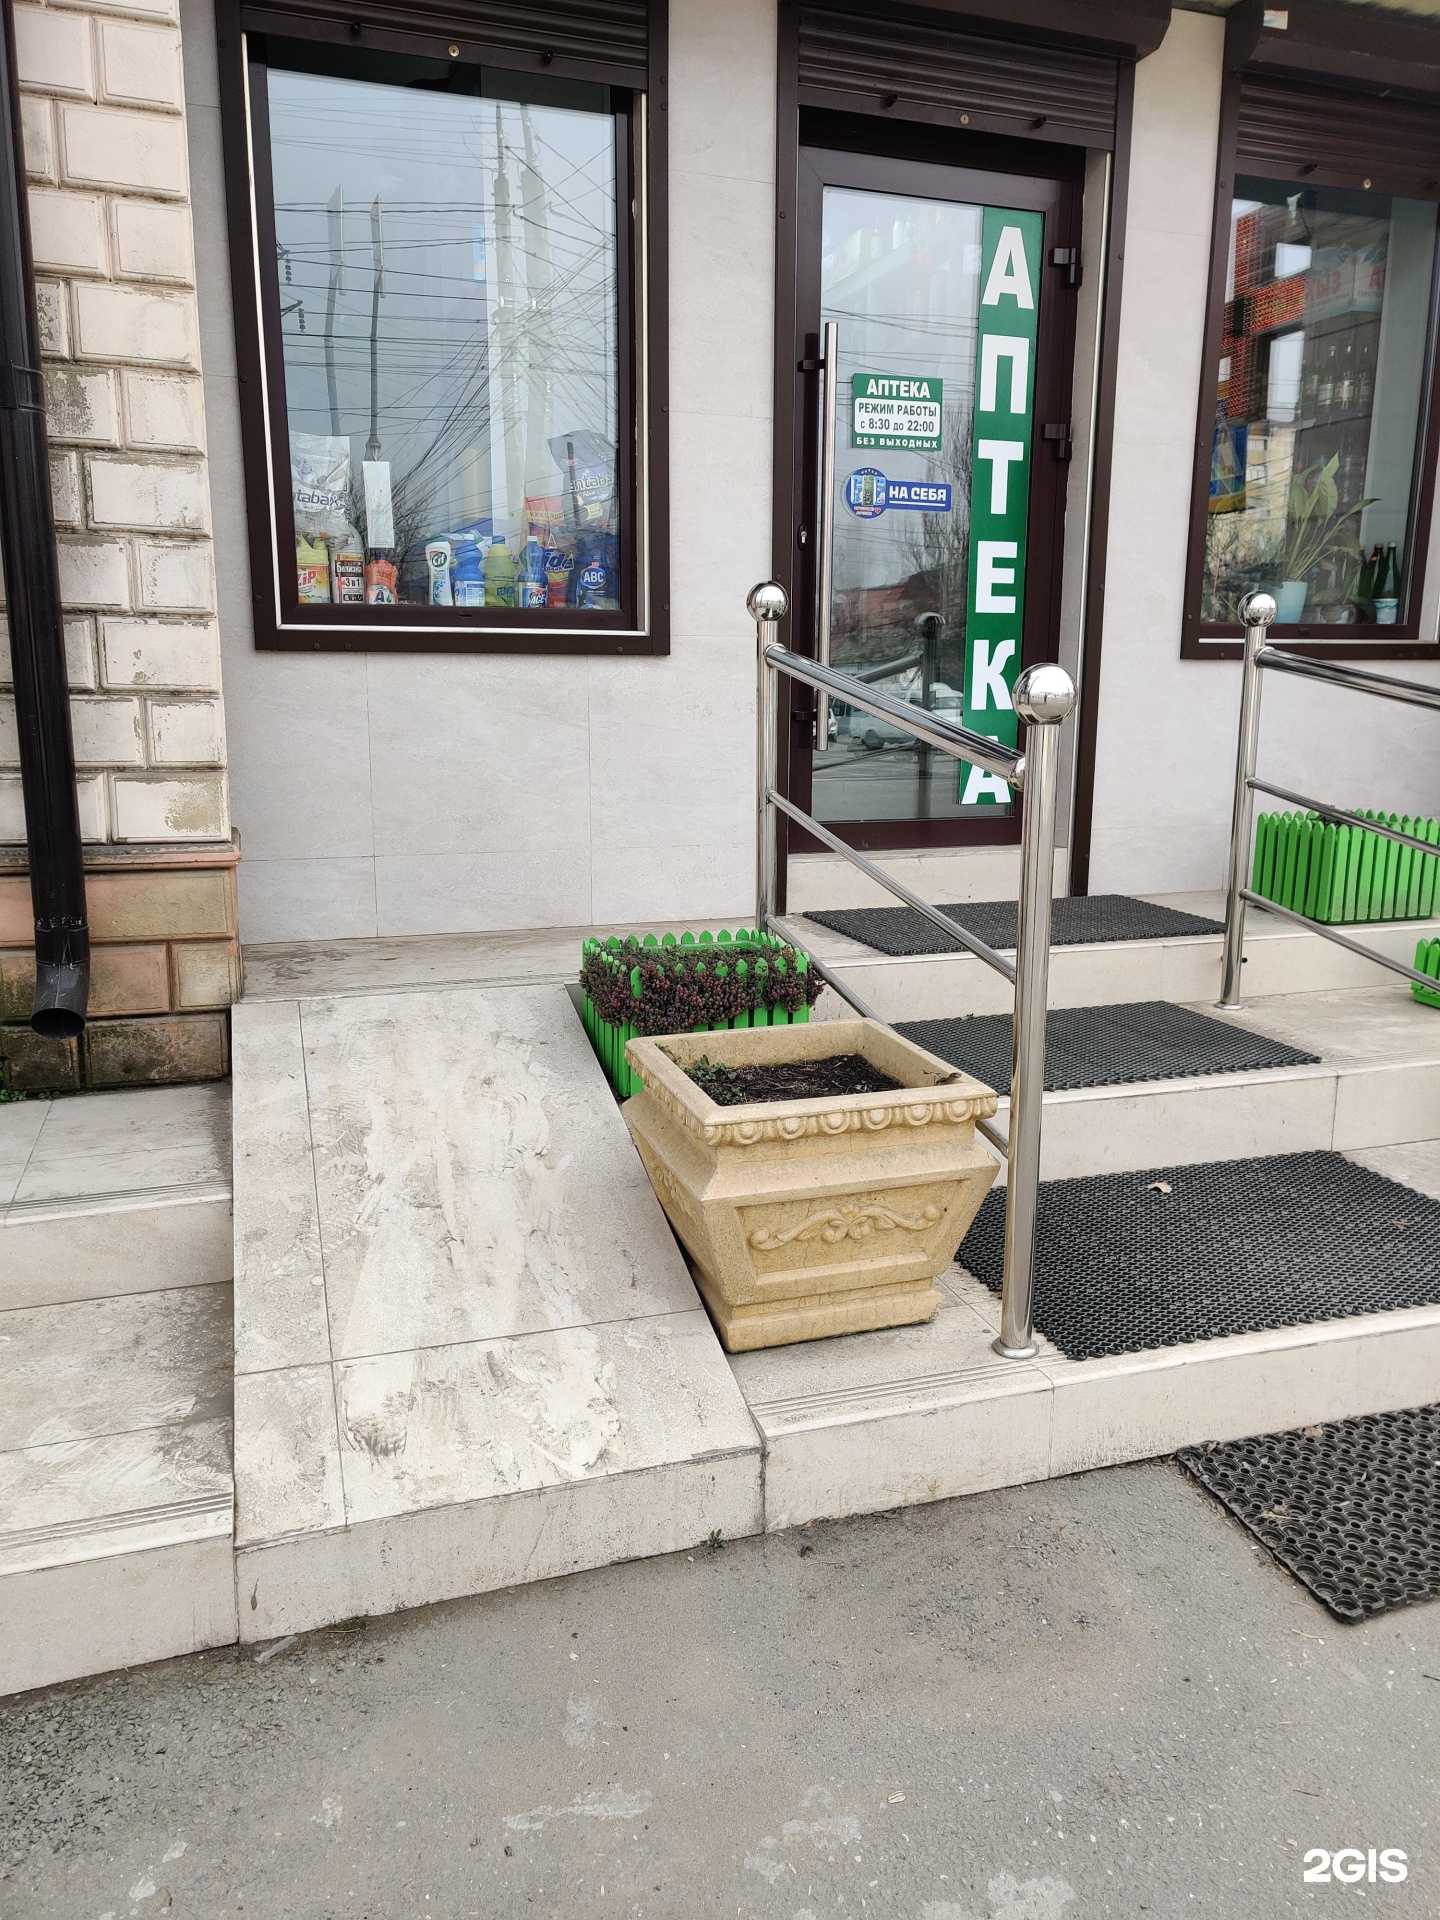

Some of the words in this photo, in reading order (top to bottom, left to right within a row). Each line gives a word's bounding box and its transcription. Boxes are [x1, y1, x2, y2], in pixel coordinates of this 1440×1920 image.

[866, 378, 931, 398] АПТЕКА
[858, 402, 894, 414] РЕЖИМ
[897, 405, 937, 417] РАБОТЫ
[860, 420, 866, 429] с
[868, 418, 890, 430] 8:30
[893, 422, 904, 431] до
[907, 420, 934, 432] 22:00
[856, 436, 875, 445] БЕЗ
[879, 438, 938, 448] ВЫХОДНЫХ
[889, 485, 909, 499] НА
[911, 487, 947, 501] СЕБЯ
[961, 226, 1034, 805] АПТЕКА
[583, 571, 604, 582] ABC
